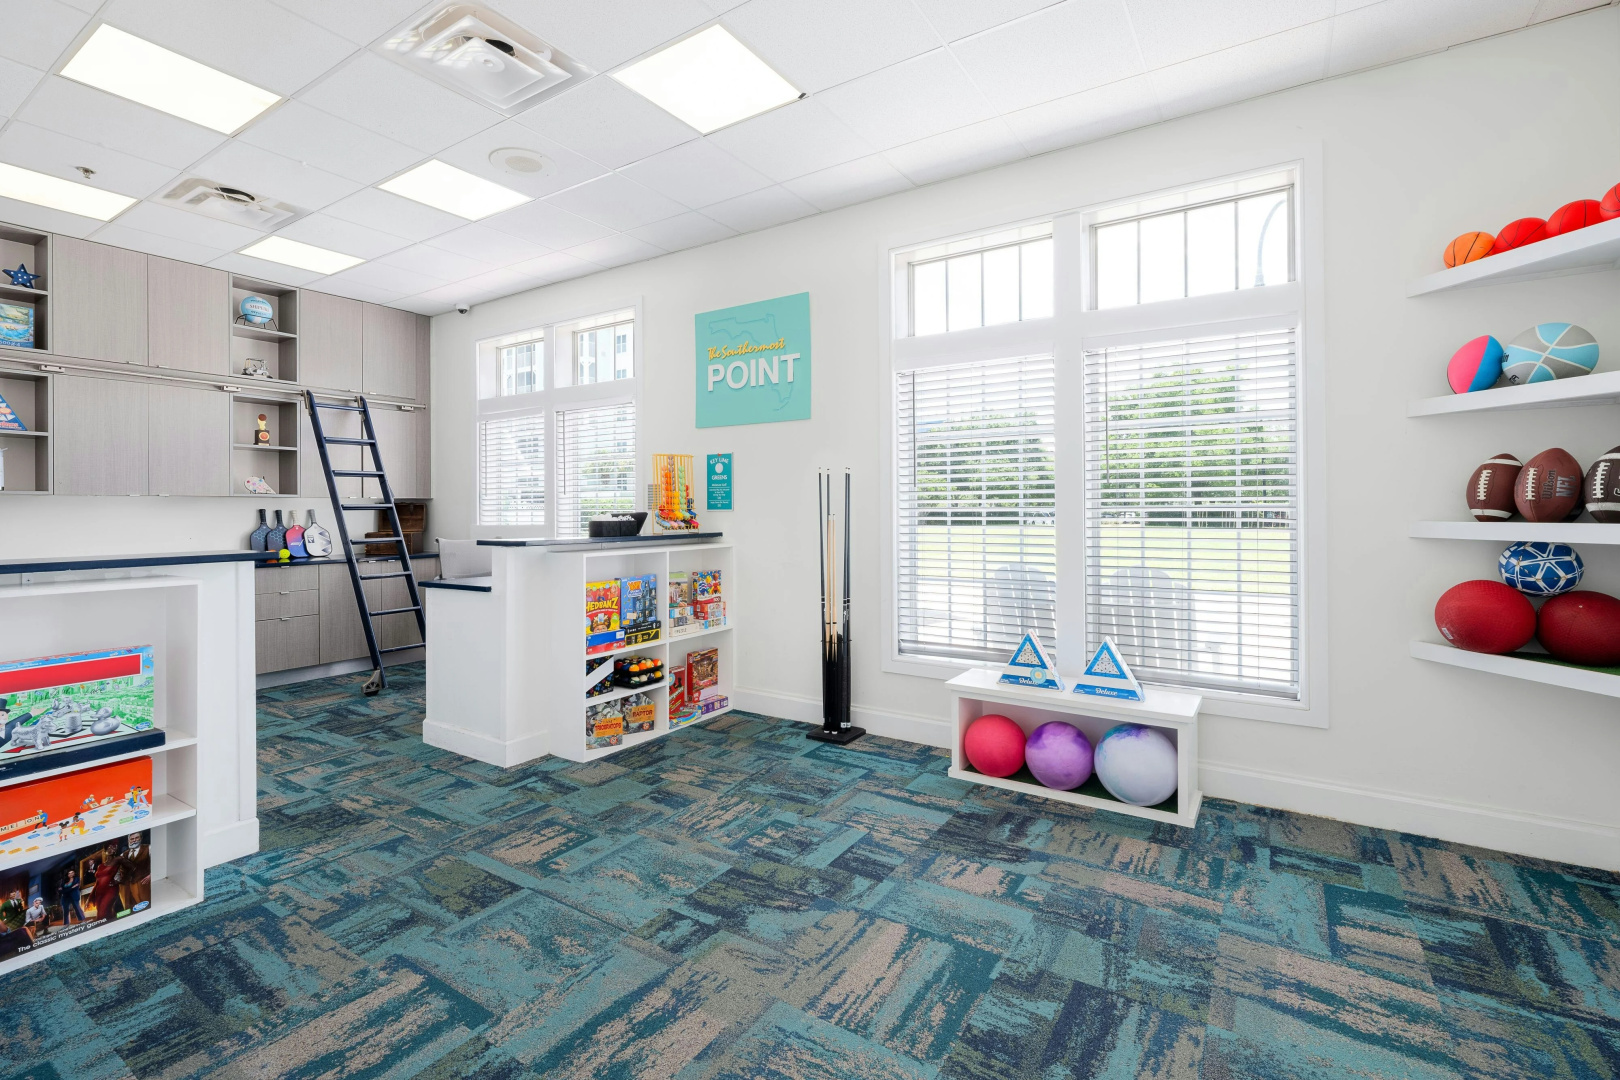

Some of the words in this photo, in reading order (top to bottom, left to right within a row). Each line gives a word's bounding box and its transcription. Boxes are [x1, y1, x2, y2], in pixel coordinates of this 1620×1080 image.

[707, 346, 721, 360] The
[707, 352, 801, 392] POINT
[1541, 470, 1556, 500] Wilson
[1556, 475, 1577, 497] NFL
[1095, 687, 1118, 696] Deluxe
[632, 709, 653, 717] RAPTOR
[18, 944, 31, 953] The
[33, 935, 57, 947] classic
[58, 925, 85, 940] mystery
[87, 917, 108, 929] game
